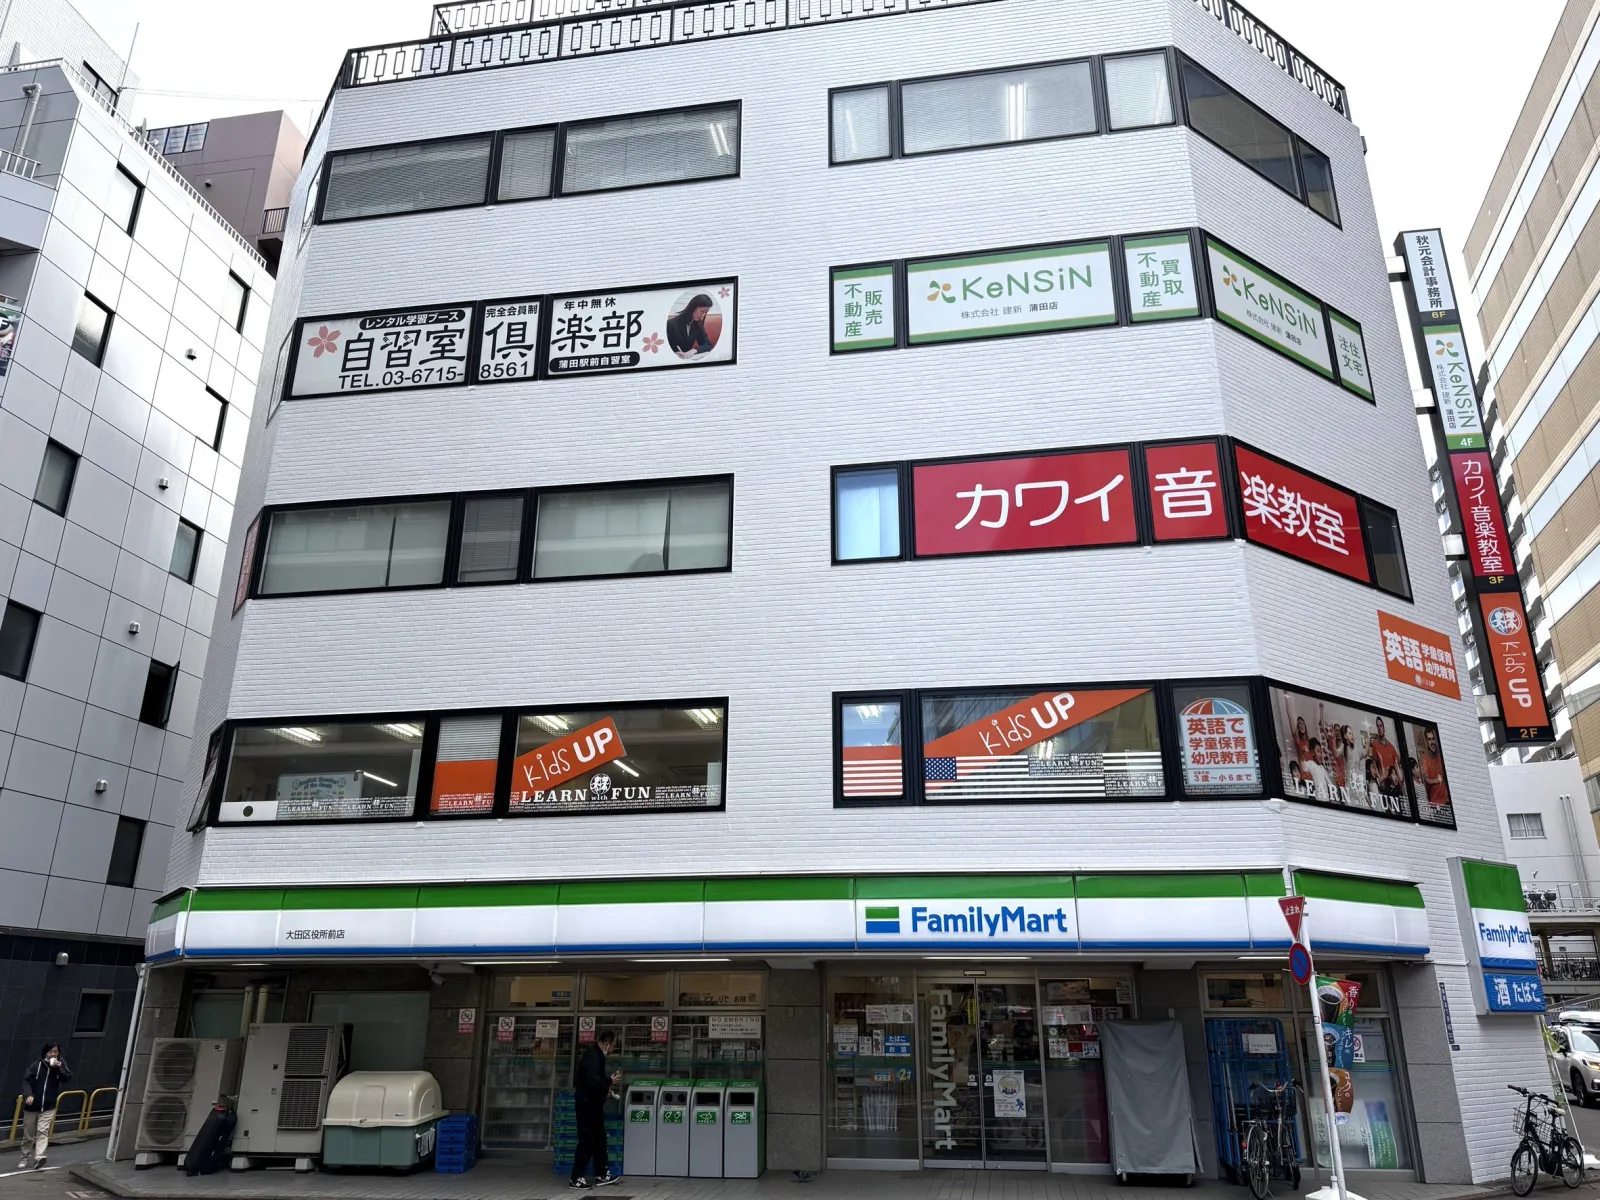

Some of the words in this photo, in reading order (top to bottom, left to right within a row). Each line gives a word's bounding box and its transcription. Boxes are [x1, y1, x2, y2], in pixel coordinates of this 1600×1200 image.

[962, 265, 1092, 301] KeNSiN
[1137, 251, 1163, 308] 不動産
[1161, 258, 1185, 296] 買取
[1416, 235, 1443, 309] 秋元会計事務所
[486, 304, 538, 318] 完全会員制
[564, 297, 617, 311] 年中無休
[844, 283, 863, 338] 不動産
[864, 289, 883, 325] 販売
[961, 307, 999, 319] 株式会社
[1003, 304, 1022, 316] 建新
[1029, 301, 1058, 312] 蒲田店
[1243, 277, 1318, 339] KeNSiN
[1431, 311, 1446, 319] 6F
[365, 311, 460, 328] レンタル学習ブース
[341, 324, 466, 373] 自習室
[551, 310, 645, 353] 楽部
[480, 361, 528, 379] 8561
[558, 354, 631, 369] 蒲田駅前自習室
[1447, 362, 1477, 428] KeNSiN
[1460, 438, 1473, 447] 4F
[954, 474, 1126, 531] カワイ
[1154, 466, 1216, 519] 音
[1240, 471, 1351, 556] 楽教室
[1462, 459, 1505, 573] カワイ音楽教室
[1488, 576, 1505, 584] 3F
[1382, 628, 1424, 672] 英語
[1420, 642, 1453, 667] 学童保育
[1424, 659, 1456, 683] 幼児教育
[1508, 678, 1532, 708] UP
[1030, 692, 1075, 729] UP
[1186, 717, 1245, 736] 英語で
[1520, 728, 1538, 739] 2F
[572, 727, 613, 763] UP
[1189, 736, 1246, 751] 学童保育
[1191, 750, 1249, 765] 幼児教育
[520, 788, 588, 802] LEARN
[591, 793, 608, 801] with
[612, 786, 651, 800] FUN
[1293, 777, 1351, 804] LEARN
[1368, 791, 1401, 812] FUN
[911, 906, 1067, 936] FamilyMart
[1284, 905, 1301, 916] 止まれ
[285, 929, 346, 941] 大田区役所前店
[1478, 922, 1533, 948] FamilyMart
[1493, 976, 1512, 1006] 酒
[1512, 981, 1541, 1003] たばこ
[926, 988, 958, 1152] FamilyMart
